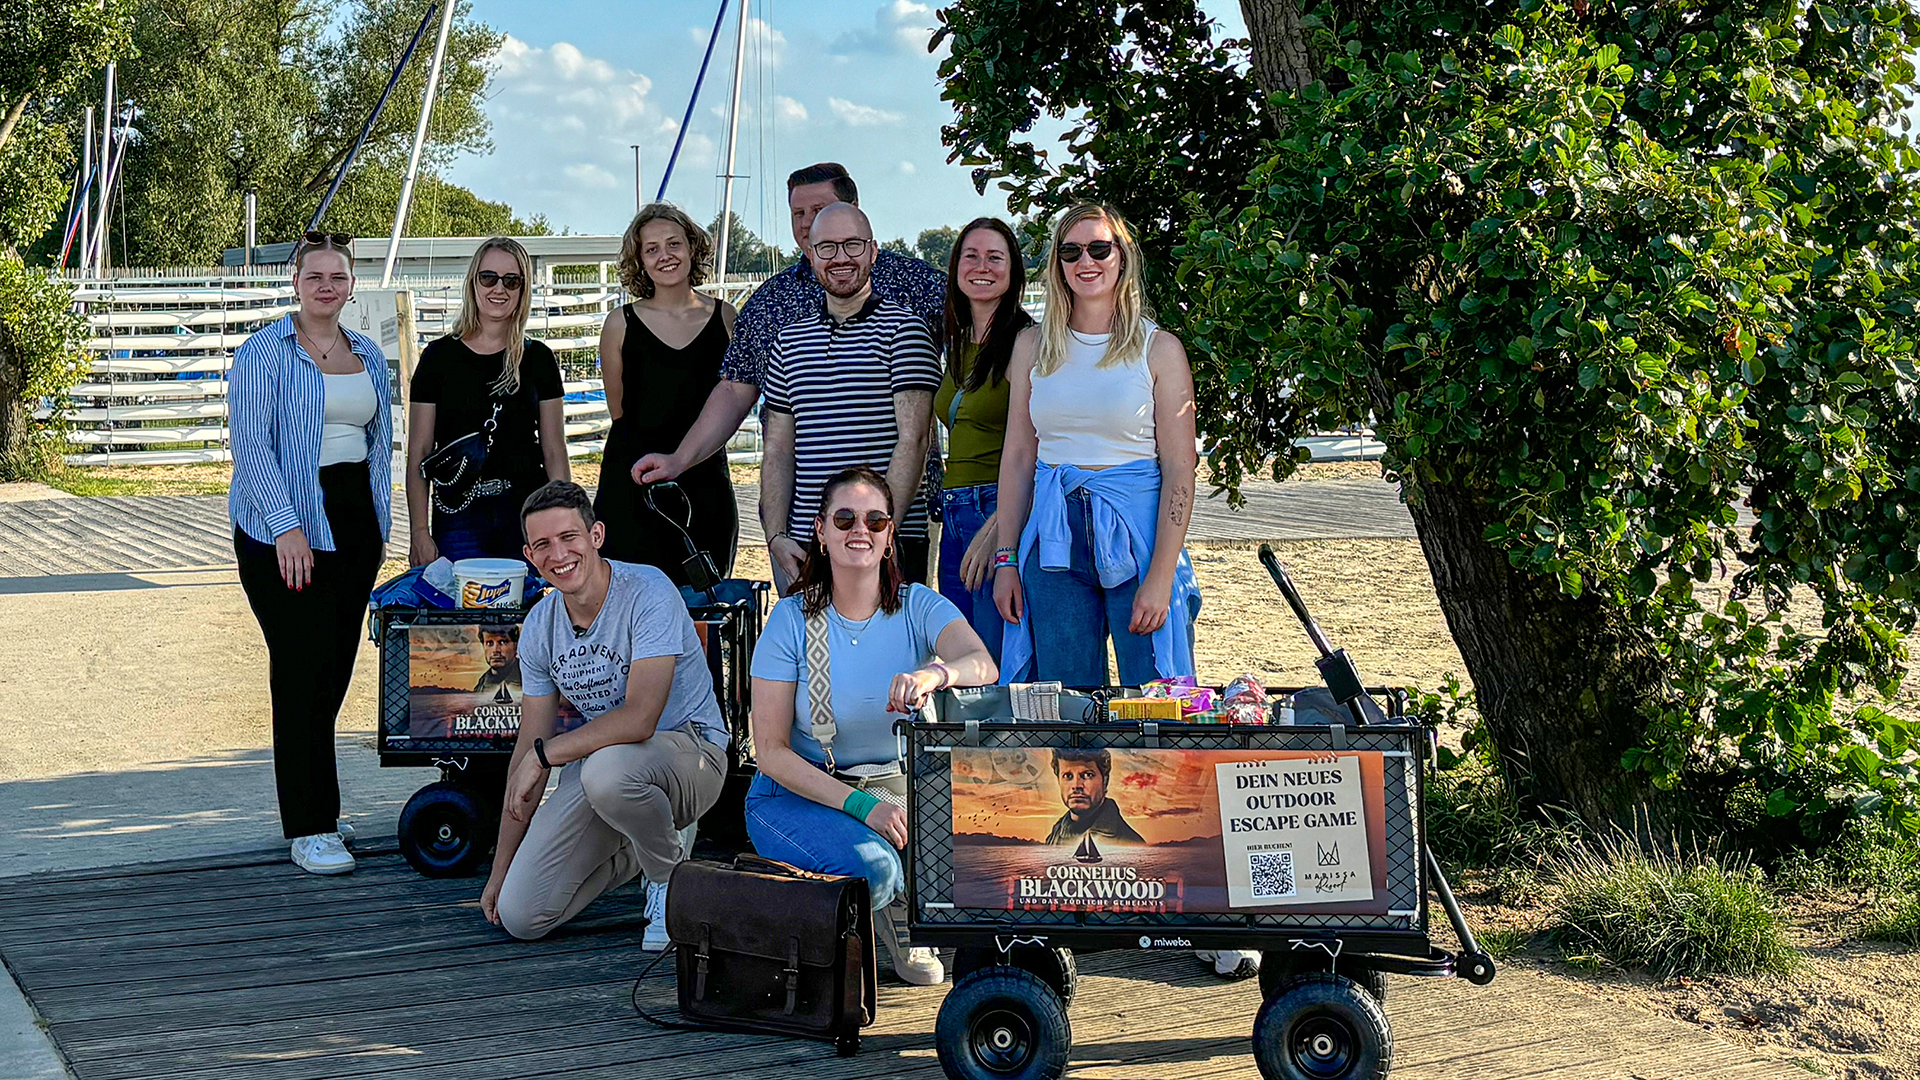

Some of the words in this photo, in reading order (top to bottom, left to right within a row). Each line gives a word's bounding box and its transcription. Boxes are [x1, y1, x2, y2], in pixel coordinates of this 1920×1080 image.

[1236, 773, 1279, 789] DEIN
[1283, 769, 1343, 787] NEUES
[1246, 791, 1337, 811] OUTDOOR
[1229, 814, 1300, 833] ESCAPE
[1303, 811, 1357, 829] GAME
[1046, 866, 1137, 881] CORNELIUS
[1304, 871, 1357, 880] MARISSA
[1020, 878, 1165, 900] BLACKWOOD
[1154, 936, 1192, 947] miweba
